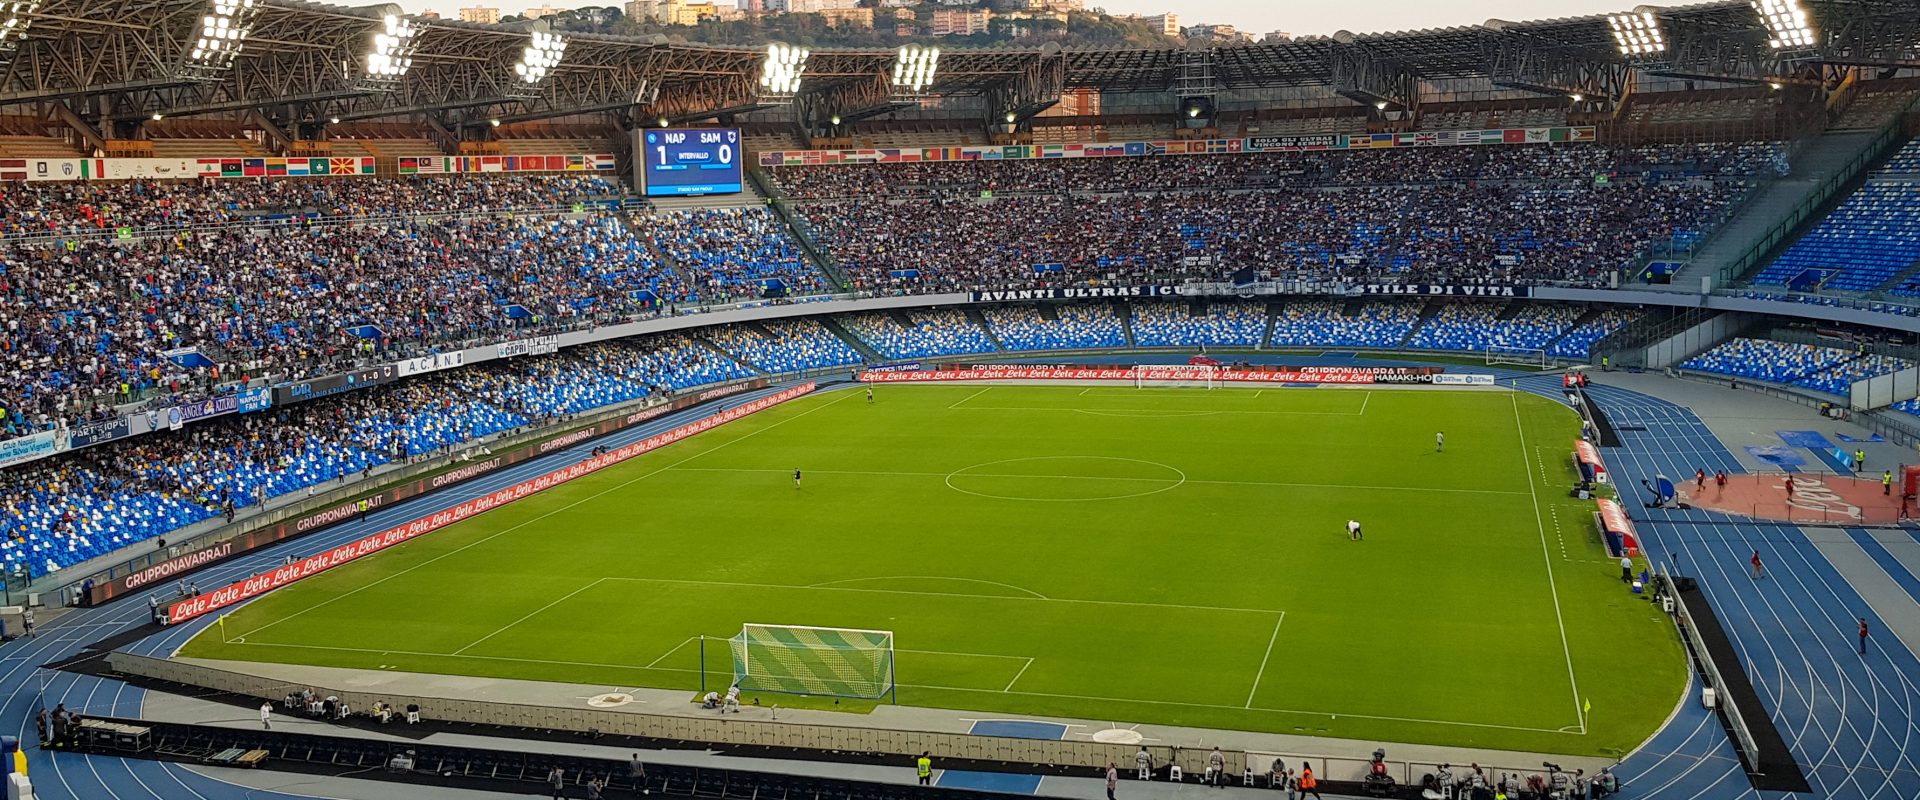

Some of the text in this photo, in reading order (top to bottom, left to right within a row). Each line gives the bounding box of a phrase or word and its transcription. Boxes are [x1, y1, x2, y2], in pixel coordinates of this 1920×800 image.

[665, 132, 720, 144] NAP SAM
[656, 144, 732, 165] 1 INTERVALLO 0
[980, 290, 1054, 300] AVANTI
[1064, 286, 1141, 298] ULTRAS
[1429, 285, 1454, 294] DI
[1462, 286, 1515, 296] VITA
[529, 334, 558, 347] APULIA
[505, 344, 526, 356] CAPRI
[177, 356, 184, 364] 12
[957, 371, 978, 379] Lete
[1028, 370, 1049, 378] Lete
[1050, 370, 1073, 378] Lete
[1075, 370, 1097, 378] Lete
[1098, 370, 1121, 378] Lete
[1148, 370, 1170, 378] Lete
[1172, 370, 1194, 379] Lete
[1221, 372, 1243, 380] Lete
[1246, 372, 1268, 380] Lete
[1271, 372, 1294, 380] Lete
[1348, 374, 1374, 382] Lete
[700, 382, 749, 400] GRUPPONAVARRA.IT
[180, 404, 202, 419] SANGUE
[245, 402, 258, 410] FAN
[628, 402, 673, 423] GRUPPONAVARRA.IT
[540, 430, 595, 452] GRUPPONAVARRA.IT
[433, 458, 501, 487] GRUPPONAVARRA.IT
[172, 598, 204, 621] Lete
[207, 588, 238, 608] Lete
[240, 576, 270, 597] Lete
[272, 566, 299, 586] Lete
[301, 555, 327, 575] Lete
[330, 545, 354, 564] Lete
[356, 537, 380, 555] Lete
[382, 528, 405, 545] Lete
[407, 520, 428, 536] Lete
[430, 510, 451, 528] Lete
[452, 504, 472, 520] Lete
[474, 496, 493, 512] Lete
[495, 490, 513, 505] Lete
[514, 483, 532, 498] Lete
[533, 477, 550, 491] Lete
[551, 471, 568, 485] Lete
[568, 465, 585, 478] Lete
[585, 459, 600, 472] Lete
[601, 454, 616, 467] Lete
[617, 448, 631, 461] Lete
[632, 443, 646, 455] Lete
[646, 438, 660, 450] Lete
[660, 433, 673, 444] Lete
[674, 428, 686, 440] Lete
[687, 424, 700, 435] Lete
[700, 420, 712, 430] Lete
[712, 415, 724, 426] Lete
[724, 410, 734, 422] Lete
[297, 495, 383, 531] GRUPPONAVAA.IT
[125, 543, 232, 589] GRUPPONAVARRA.IT
